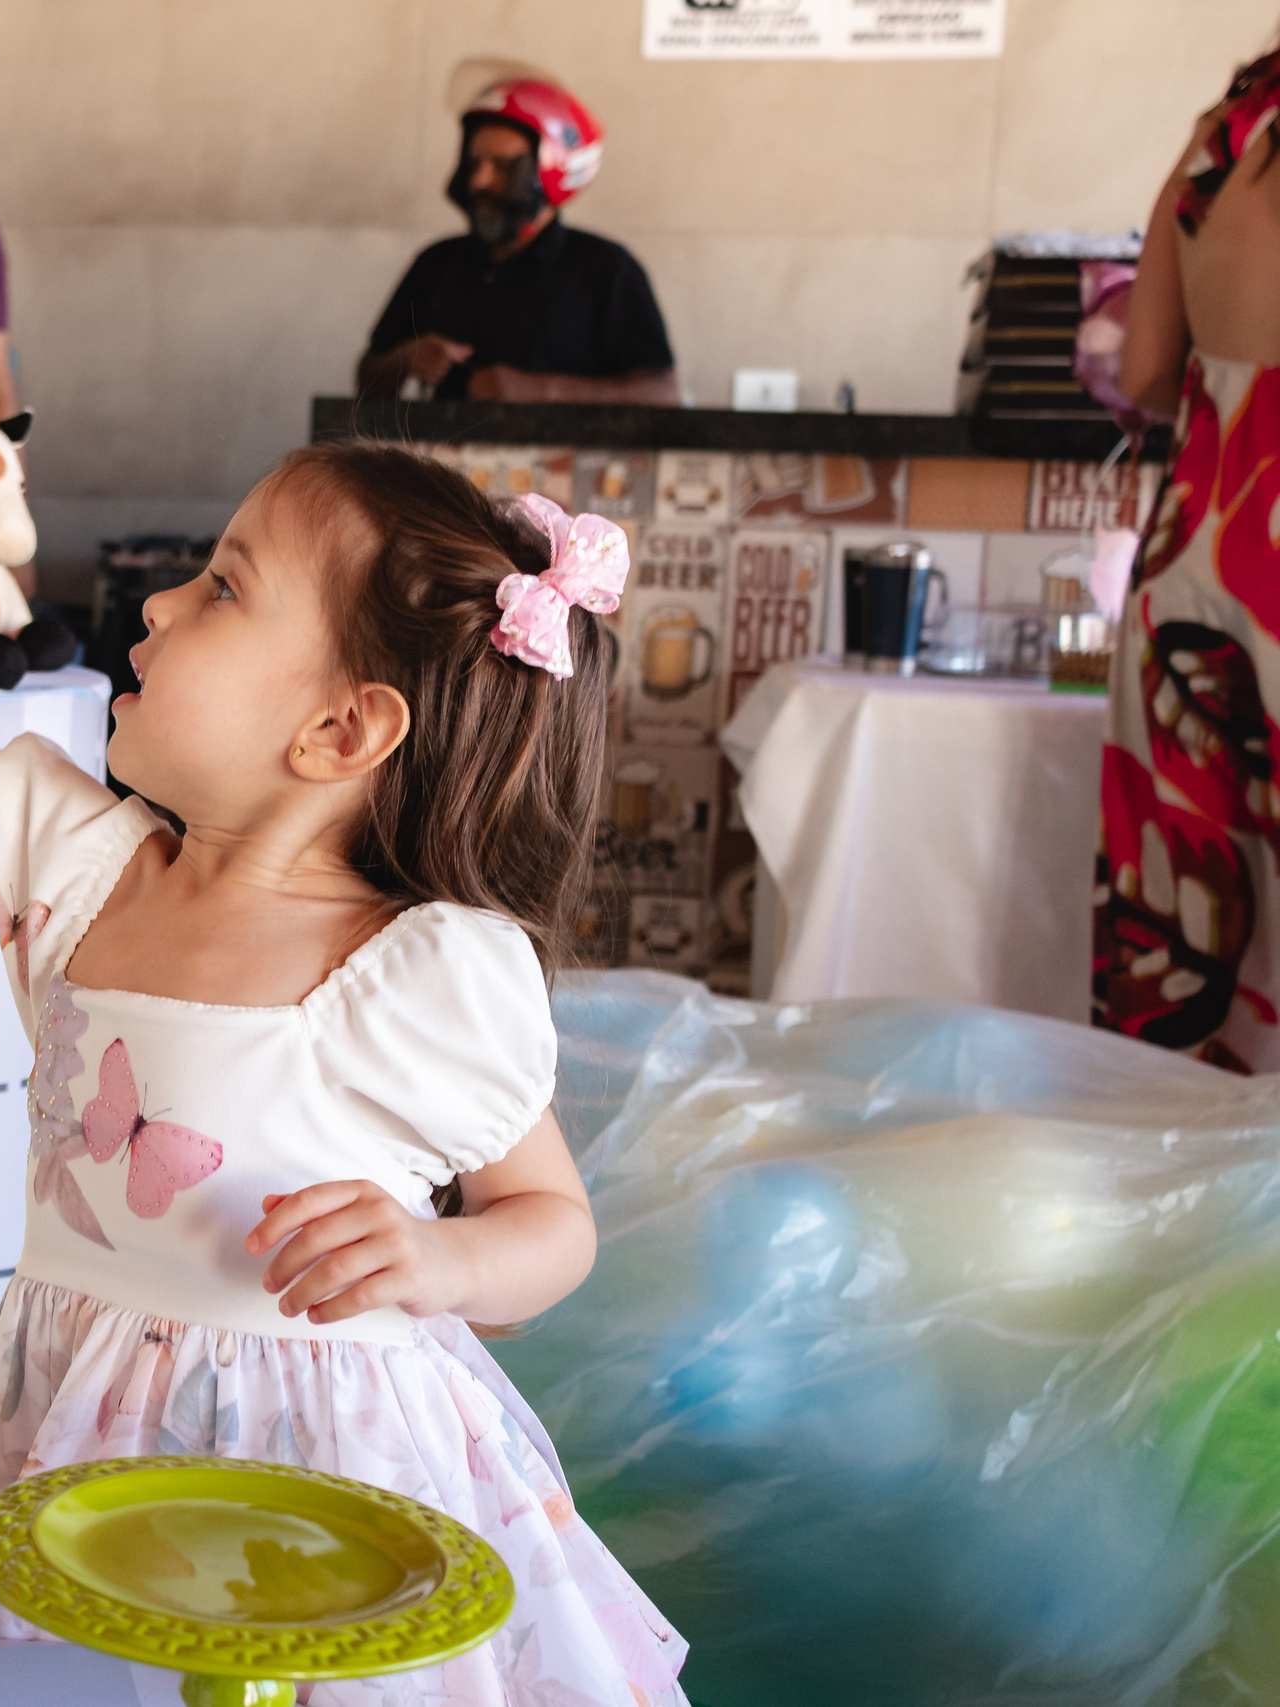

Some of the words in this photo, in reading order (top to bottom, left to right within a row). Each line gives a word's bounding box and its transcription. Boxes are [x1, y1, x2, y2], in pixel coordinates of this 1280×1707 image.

[646, 536, 714, 557] COLD
[637, 563, 718, 591] BEER
[732, 597, 812, 669] BEER
